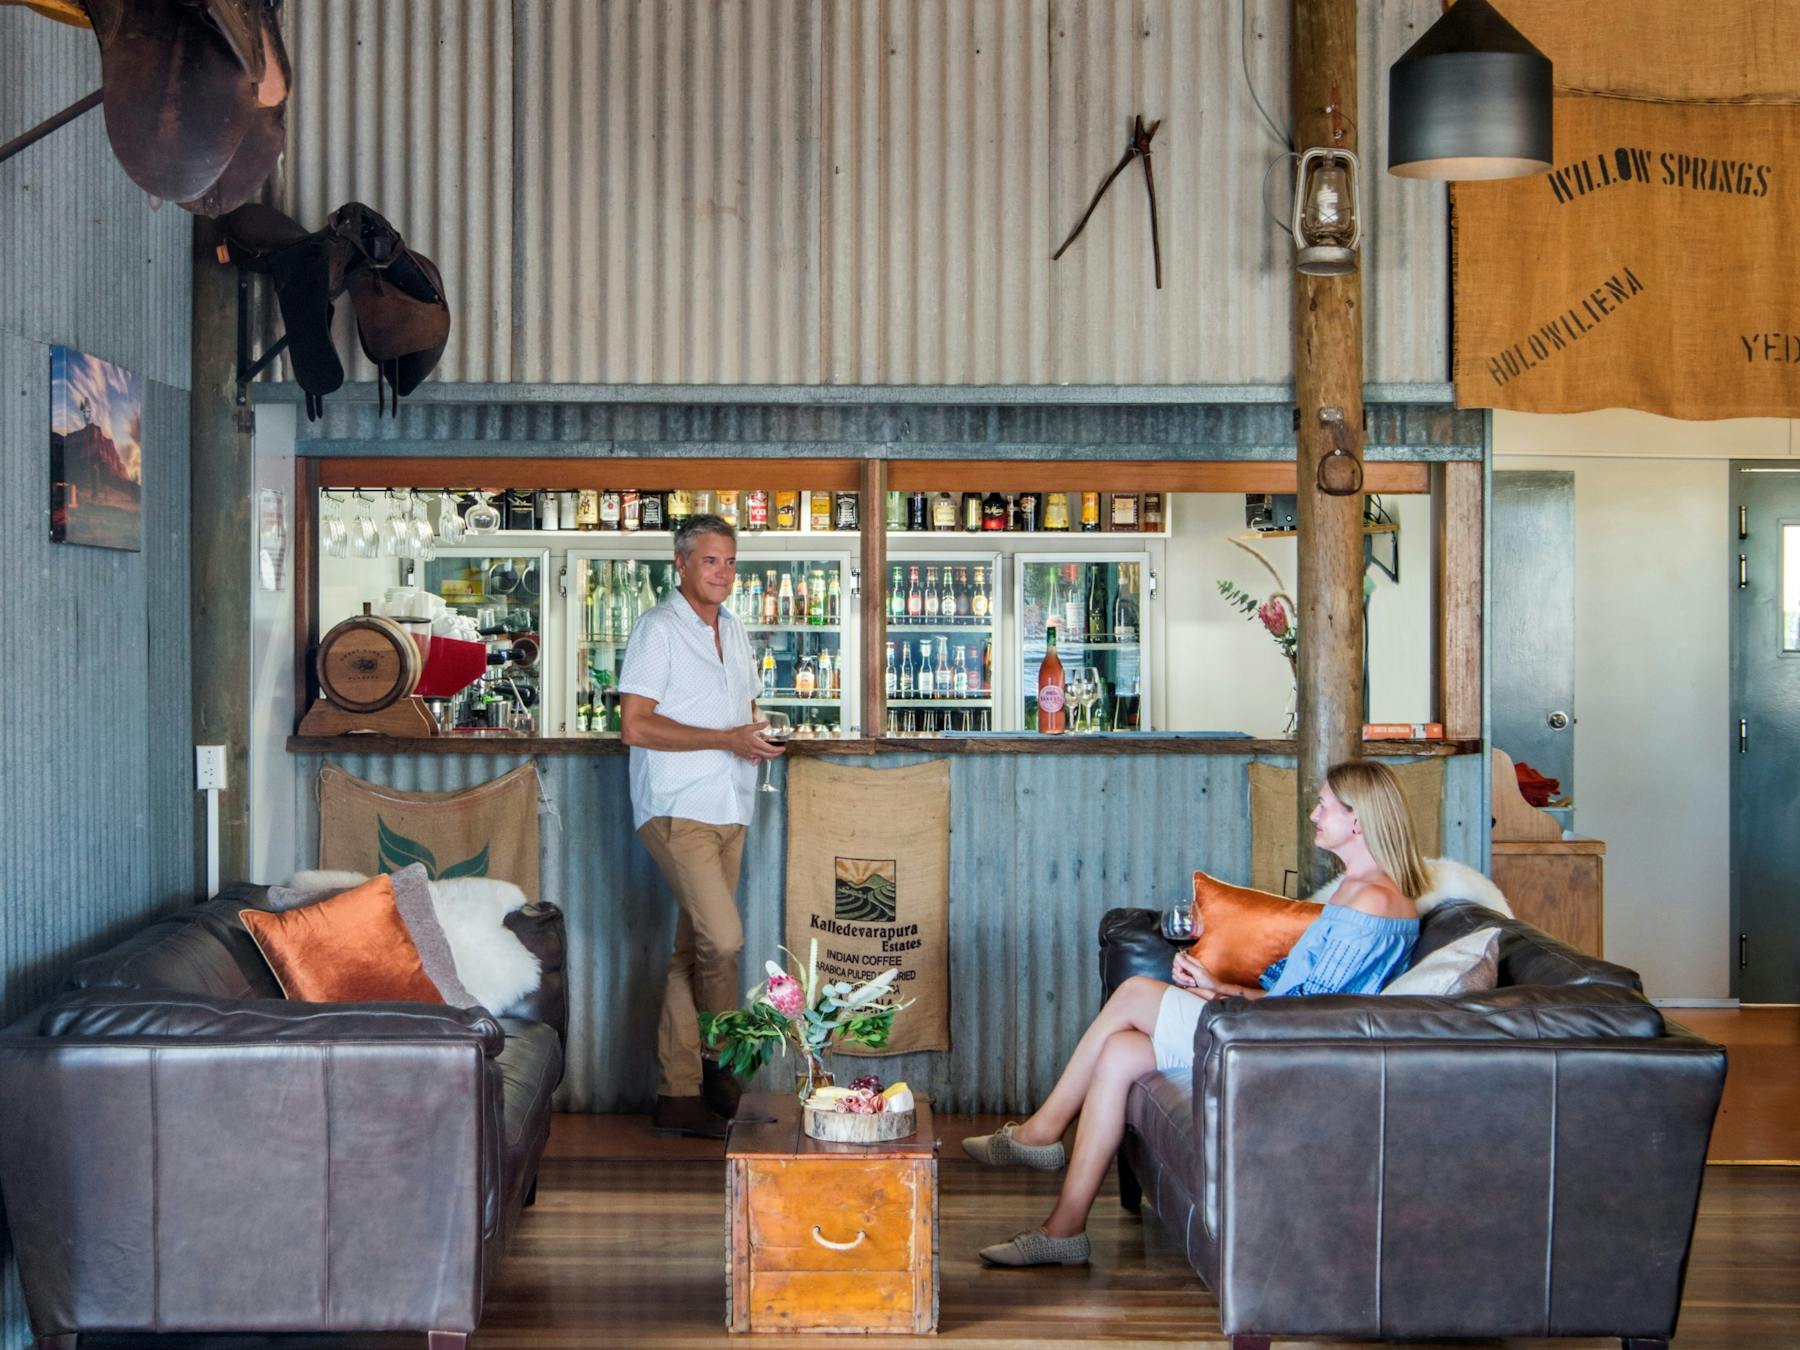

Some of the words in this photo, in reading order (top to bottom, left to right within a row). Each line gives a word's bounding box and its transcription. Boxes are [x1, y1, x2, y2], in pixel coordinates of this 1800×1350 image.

[1548, 147, 1651, 204] WILLOW
[1660, 152, 1772, 197] SPRINGS
[810, 913, 918, 940] Kalledevarapura
[882, 938, 922, 952] Estates
[827, 949, 859, 964] INDIAN
[861, 955, 902, 966] COFFEE
[816, 961, 847, 977] ARABICA
[847, 968, 877, 980] PULPED
